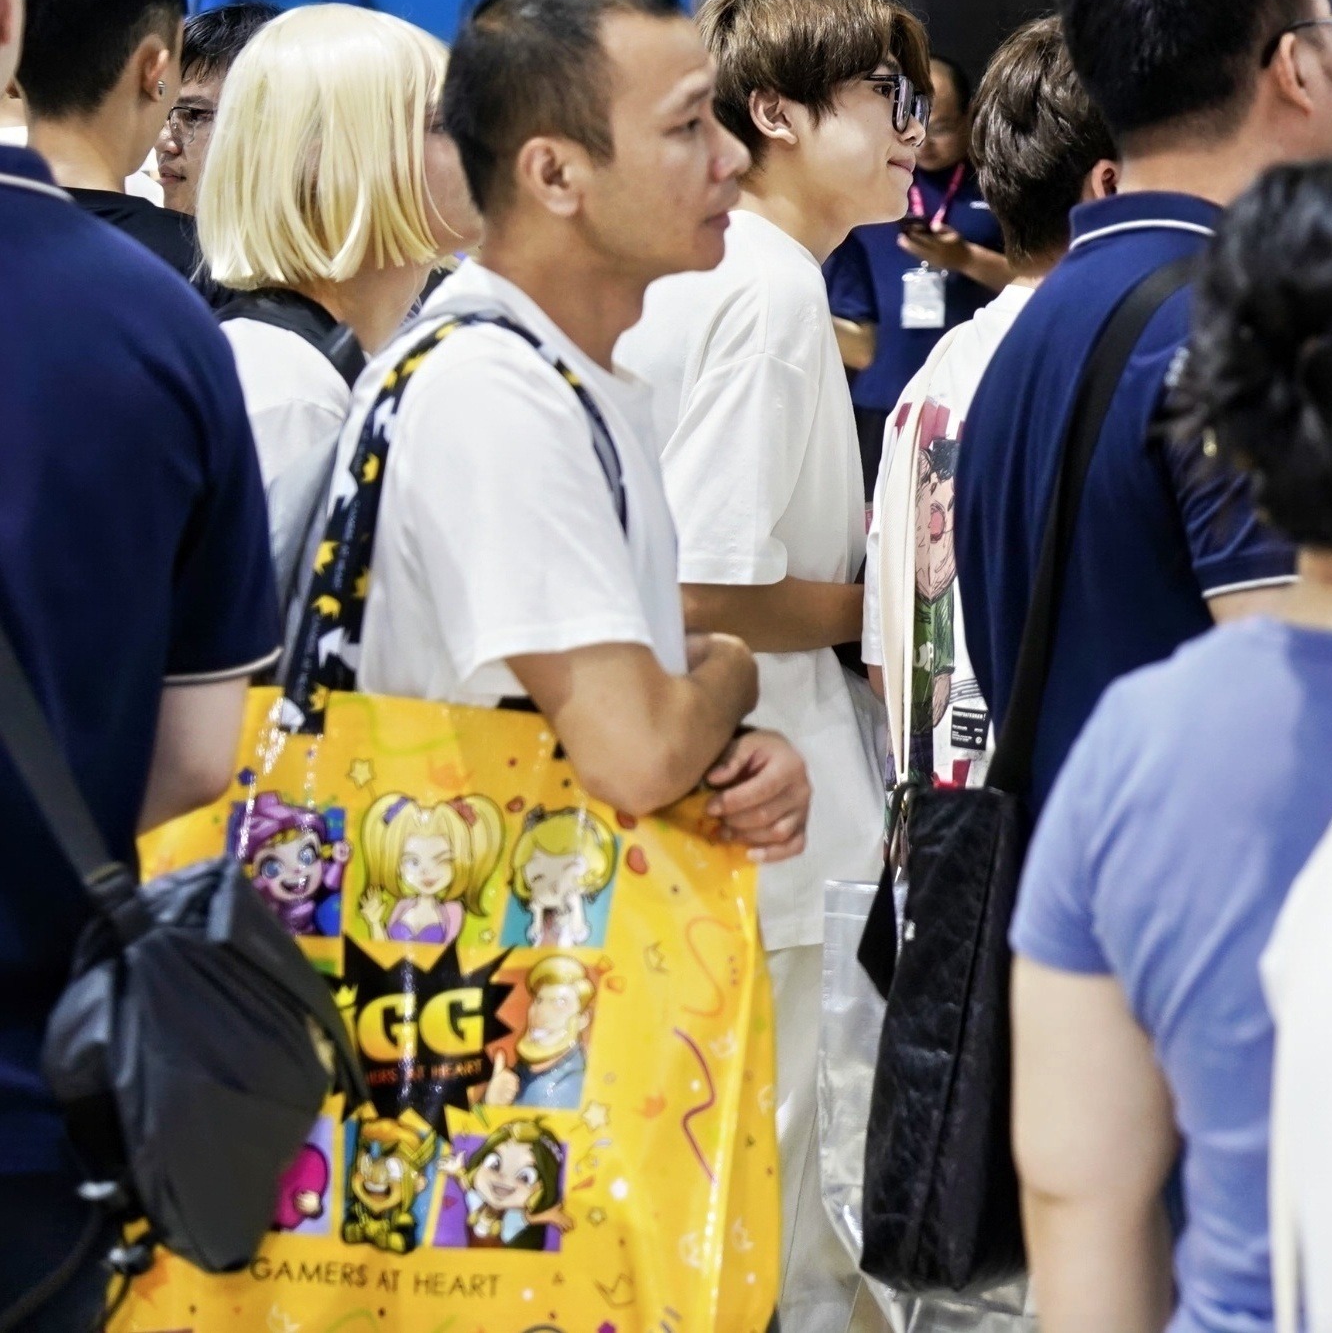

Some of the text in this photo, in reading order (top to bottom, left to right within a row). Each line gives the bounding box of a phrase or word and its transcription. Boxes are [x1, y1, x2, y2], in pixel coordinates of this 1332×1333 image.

[249, 1259, 501, 1299] GAMERS AT HEART
